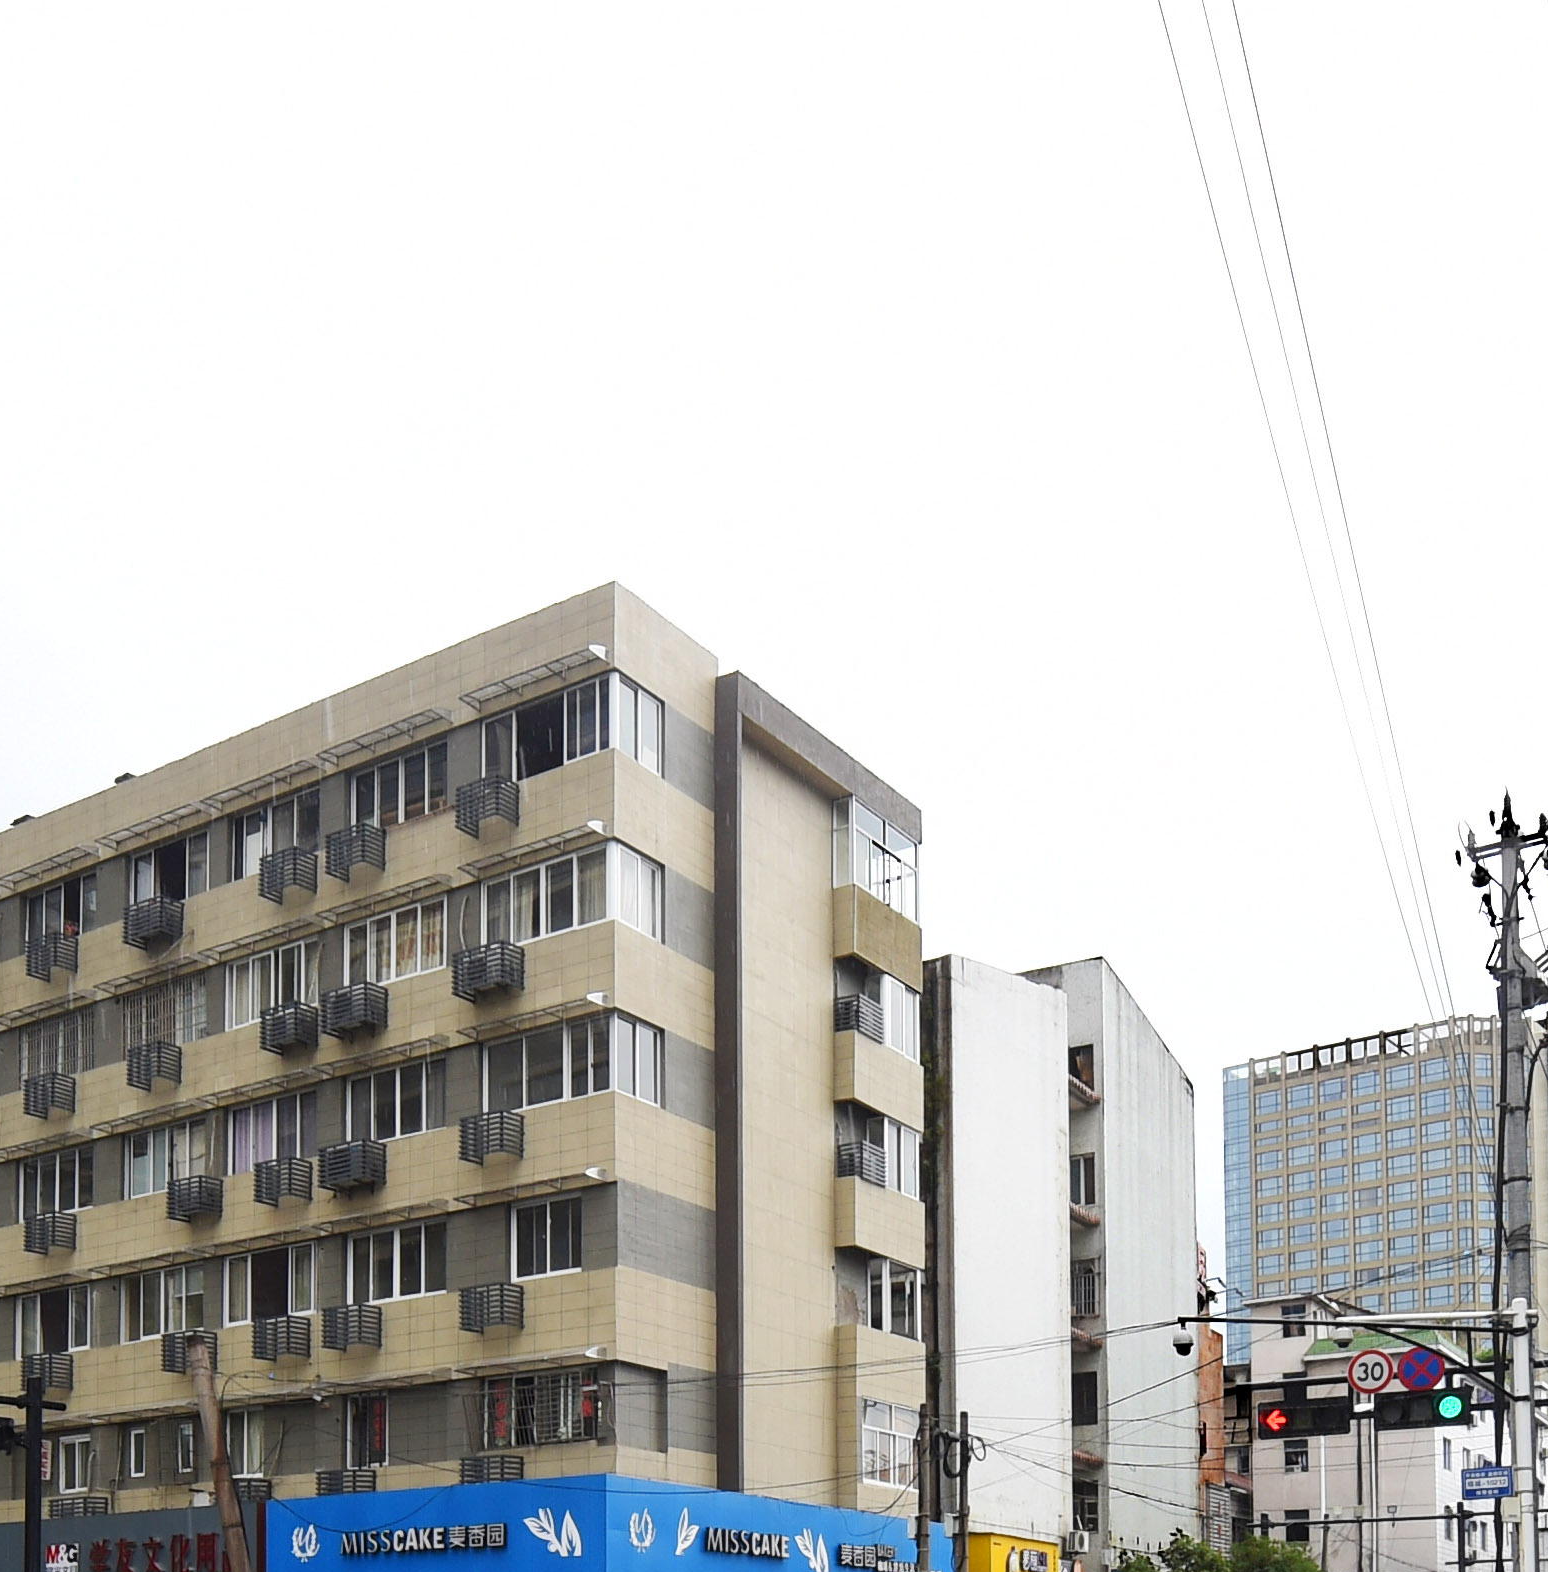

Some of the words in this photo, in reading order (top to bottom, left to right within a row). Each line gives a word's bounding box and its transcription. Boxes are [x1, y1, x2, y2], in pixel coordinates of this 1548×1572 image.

[1357, 1361, 1384, 1382] 30
[448, 1523, 507, 1549] 麦香园
[46, 1544, 79, 1564] M&G
[841, 1544, 876, 1568] 麦香园
